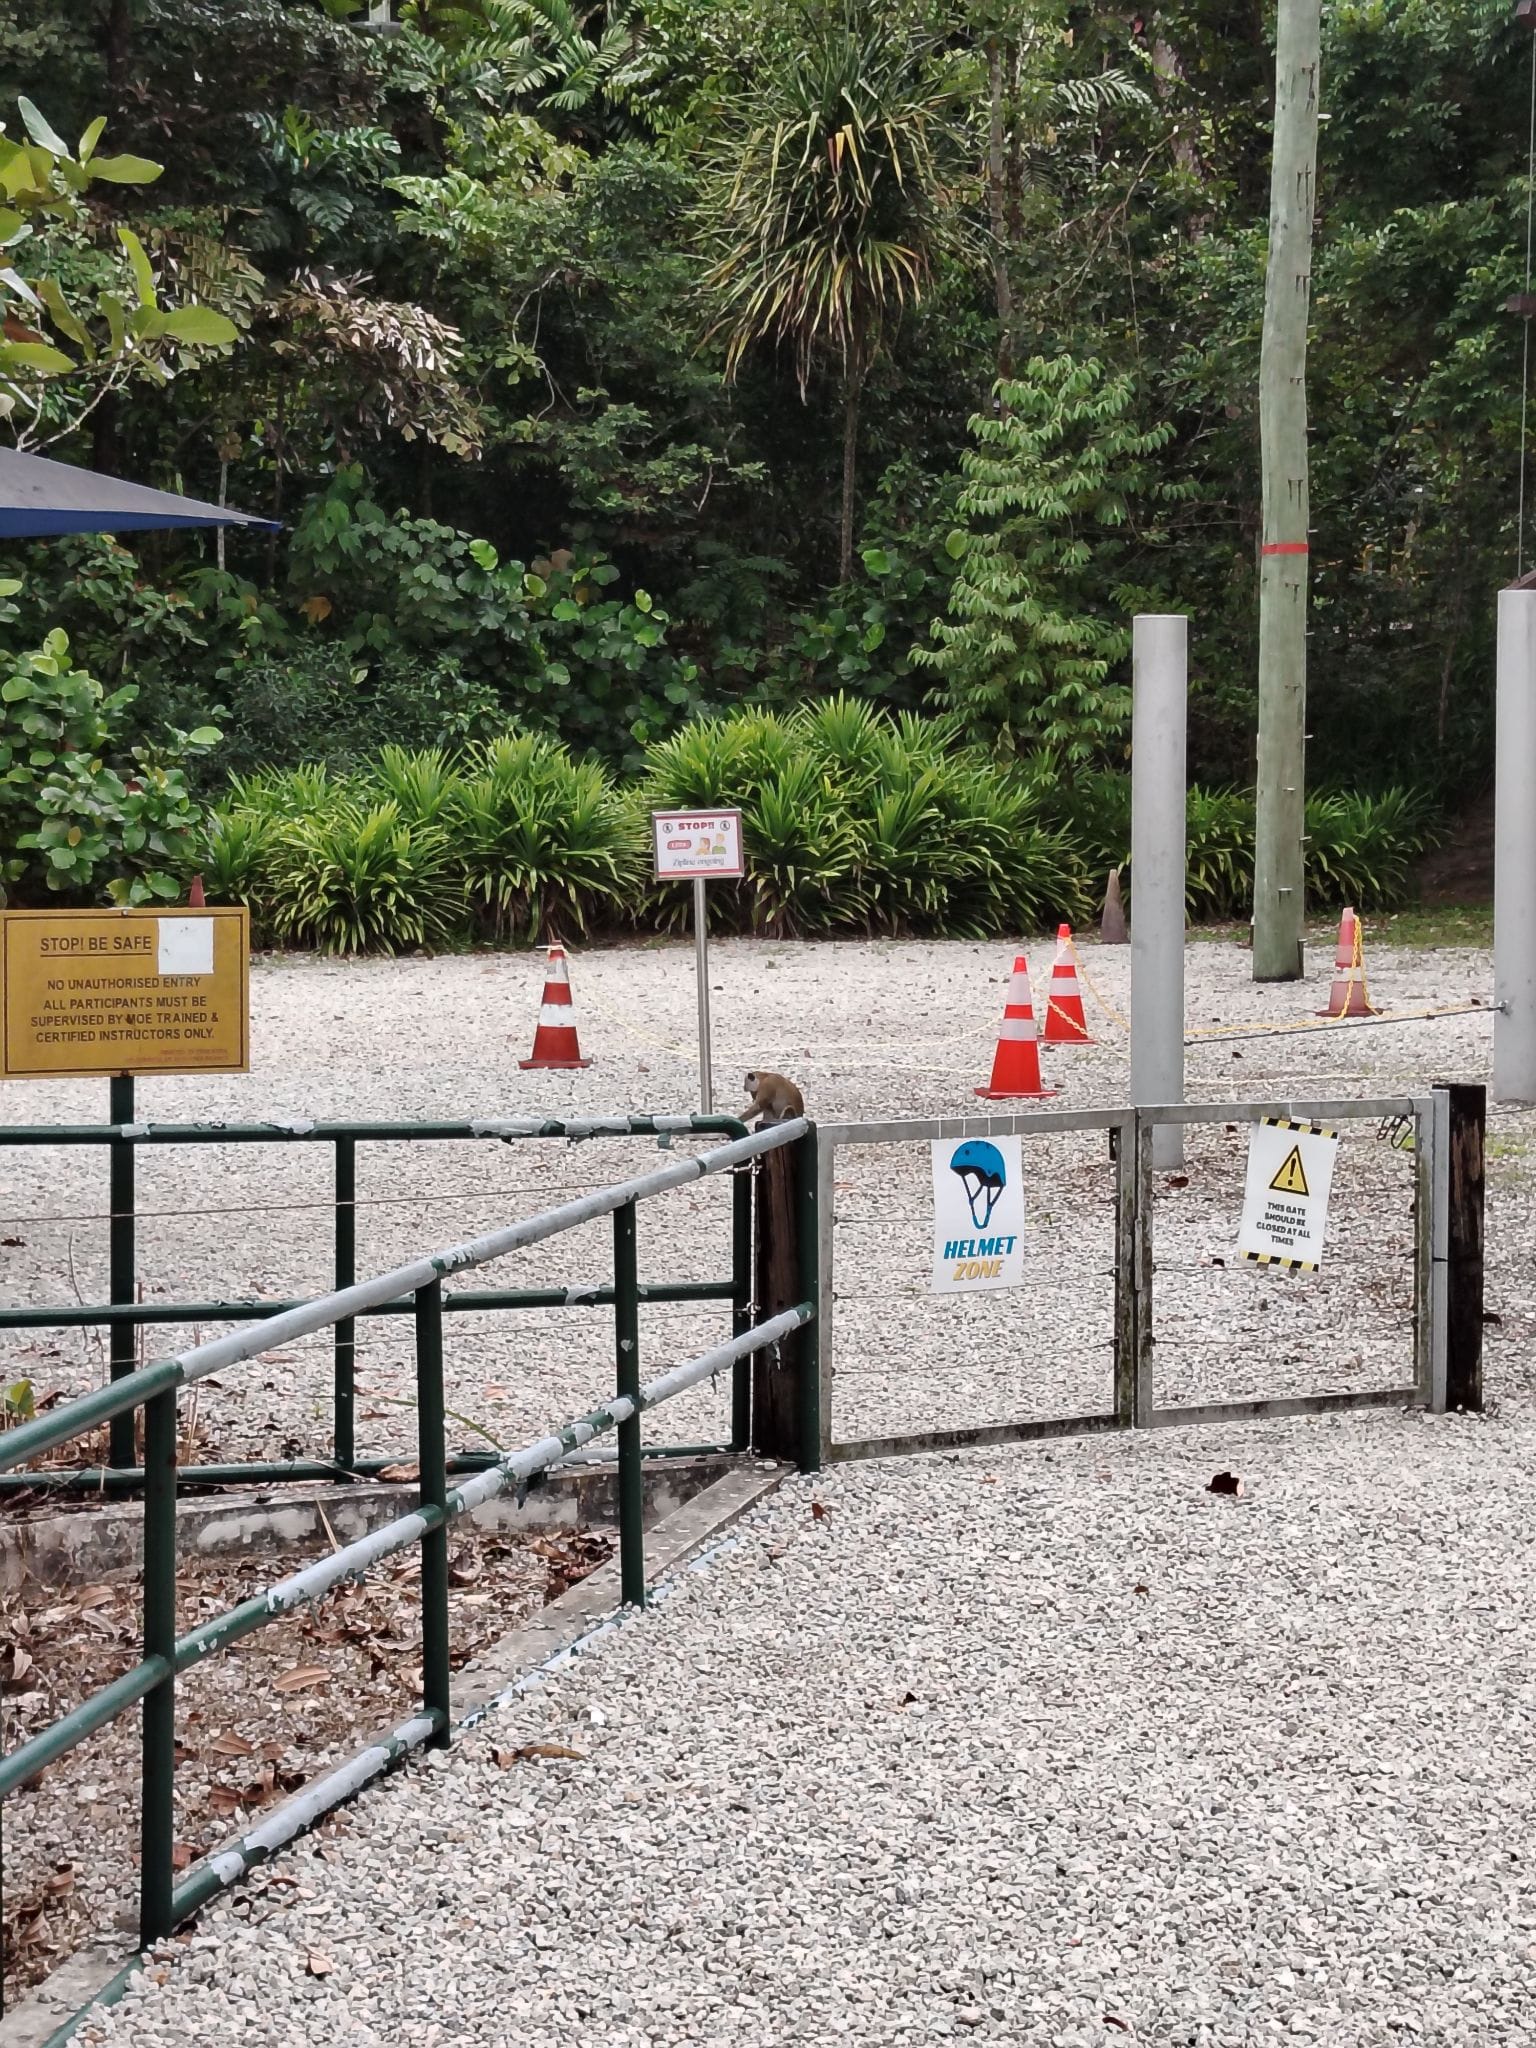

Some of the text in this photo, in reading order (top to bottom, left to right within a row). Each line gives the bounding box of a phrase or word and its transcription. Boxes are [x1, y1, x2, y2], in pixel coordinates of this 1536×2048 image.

[678, 822, 715, 830] STOP!!
[40, 936, 152, 951] STOP! BE SAFE
[47, 976, 201, 990] NO UNAUTHORISED ENTRY
[43, 996, 207, 1010] ALL PARTICIPANTS MUST BE
[31, 1012, 218, 1027] SUPERVISED BY MOE TRAINED &
[36, 1028, 214, 1043] CERTIFIED INSTRUCTORS ONLY.
[1267, 1202, 1306, 1216] THIS GATE
[1264, 1212, 1306, 1226] SHOULD BE
[1256, 1222, 1311, 1238] CLOSED AT ALL
[943, 1236, 1018, 1259] HELMET
[1271, 1235, 1294, 1246] TIMES
[953, 1260, 1005, 1281] ZONE
